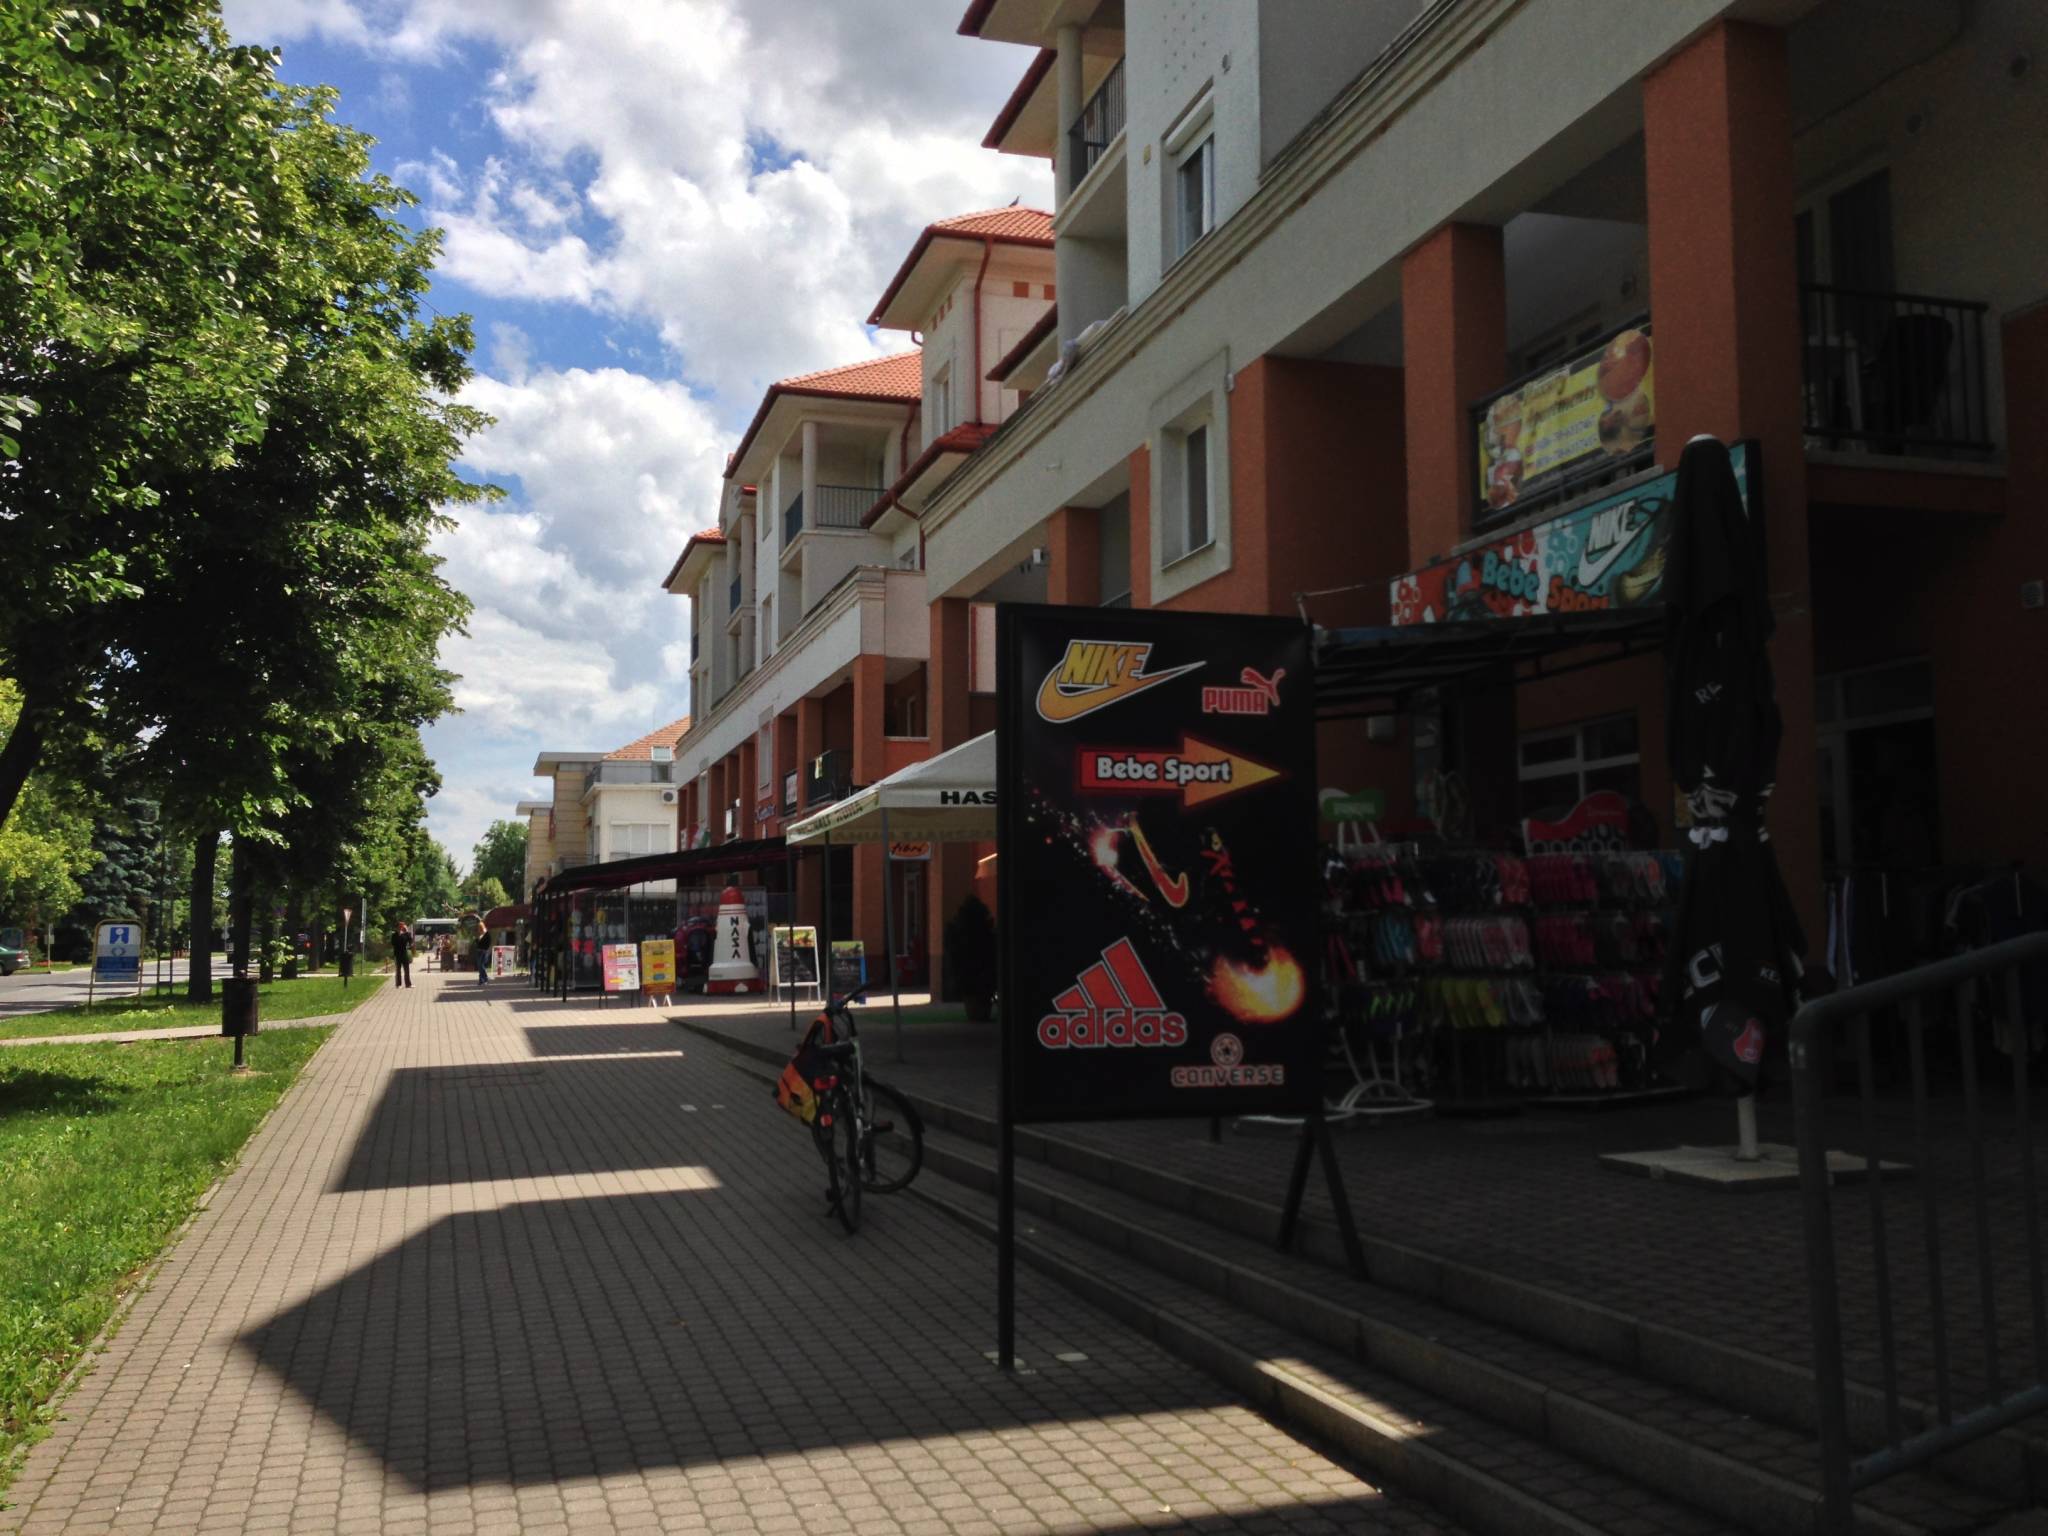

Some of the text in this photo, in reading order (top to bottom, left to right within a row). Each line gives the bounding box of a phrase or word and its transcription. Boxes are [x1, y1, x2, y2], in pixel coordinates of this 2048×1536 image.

[1588, 500, 1642, 550] NIKE
[1482, 549, 1540, 600] Bebe
[1058, 641, 1153, 687] NIKE
[1202, 686, 1269, 714] PUMA
[1096, 756, 1232, 785] Bebe Sport
[730, 916, 741, 959] NASA
[1038, 1008, 1188, 1048] adidas
[1170, 1065, 1286, 1087] CONVERSE
